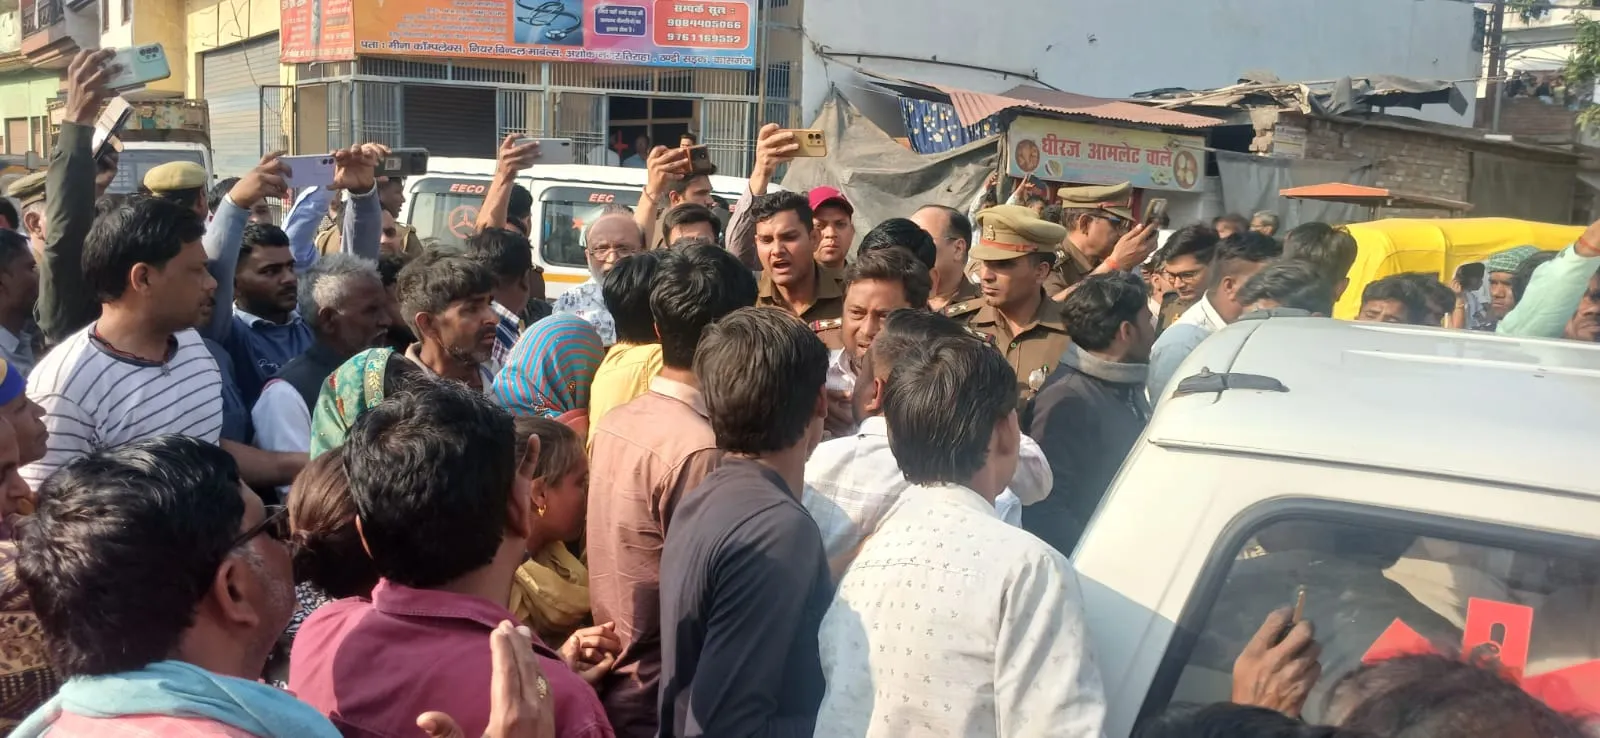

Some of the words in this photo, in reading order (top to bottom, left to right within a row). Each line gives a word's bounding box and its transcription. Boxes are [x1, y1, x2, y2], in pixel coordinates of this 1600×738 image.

[674, 3, 704, 13] सम्पर्क
[667, 18, 741, 29] 9084405066
[667, 32, 741, 43] 9761169552
[361, 41, 378, 49] पता
[389, 40, 410, 50] मीना
[469, 43, 493, 53] नियर
[1042, 134, 1081, 158] धीरज
[1088, 142, 1141, 164] आमलेट
[1145, 145, 1173, 167] वाले
[450, 183, 485, 194] EECO
[589, 193, 615, 203] EEC
